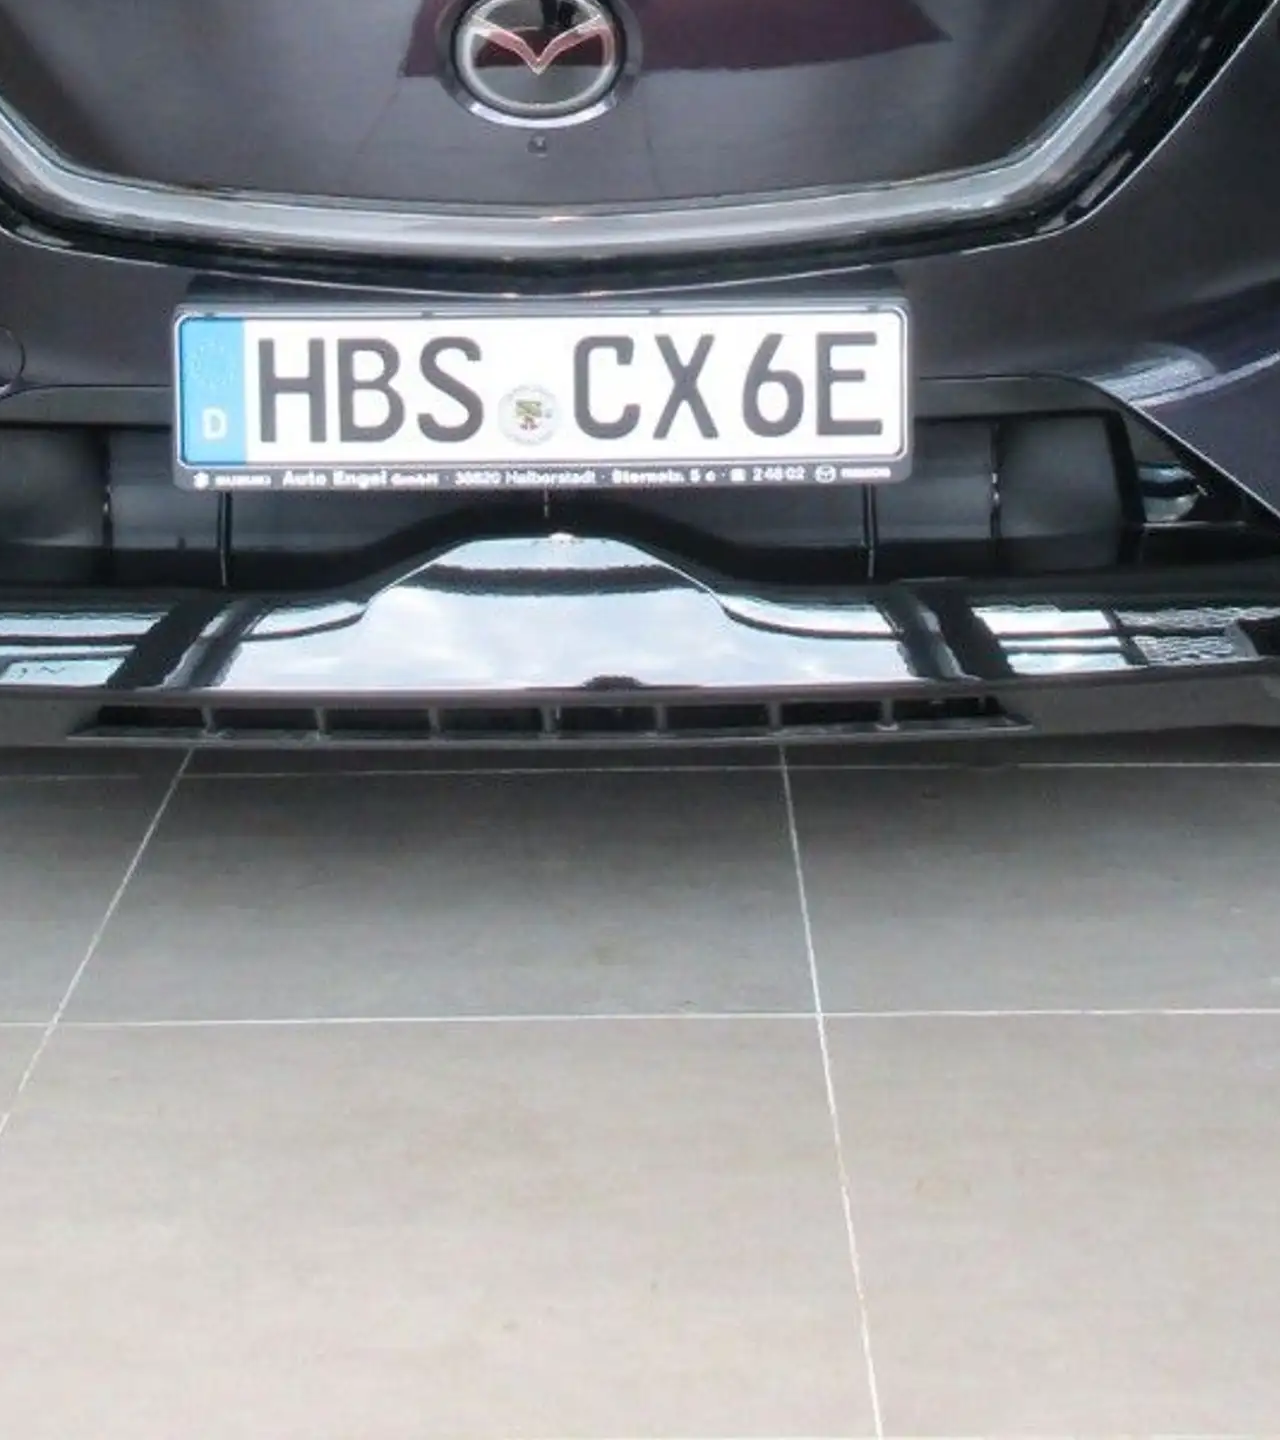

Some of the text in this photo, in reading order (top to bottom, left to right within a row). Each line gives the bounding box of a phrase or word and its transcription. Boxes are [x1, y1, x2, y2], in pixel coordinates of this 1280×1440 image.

[257, 335, 485, 444] HBS
[201, 407, 229, 441] D
[282, 468, 327, 487] Auto
[332, 468, 388, 490] Engel
[505, 467, 597, 485] Halberstadt
